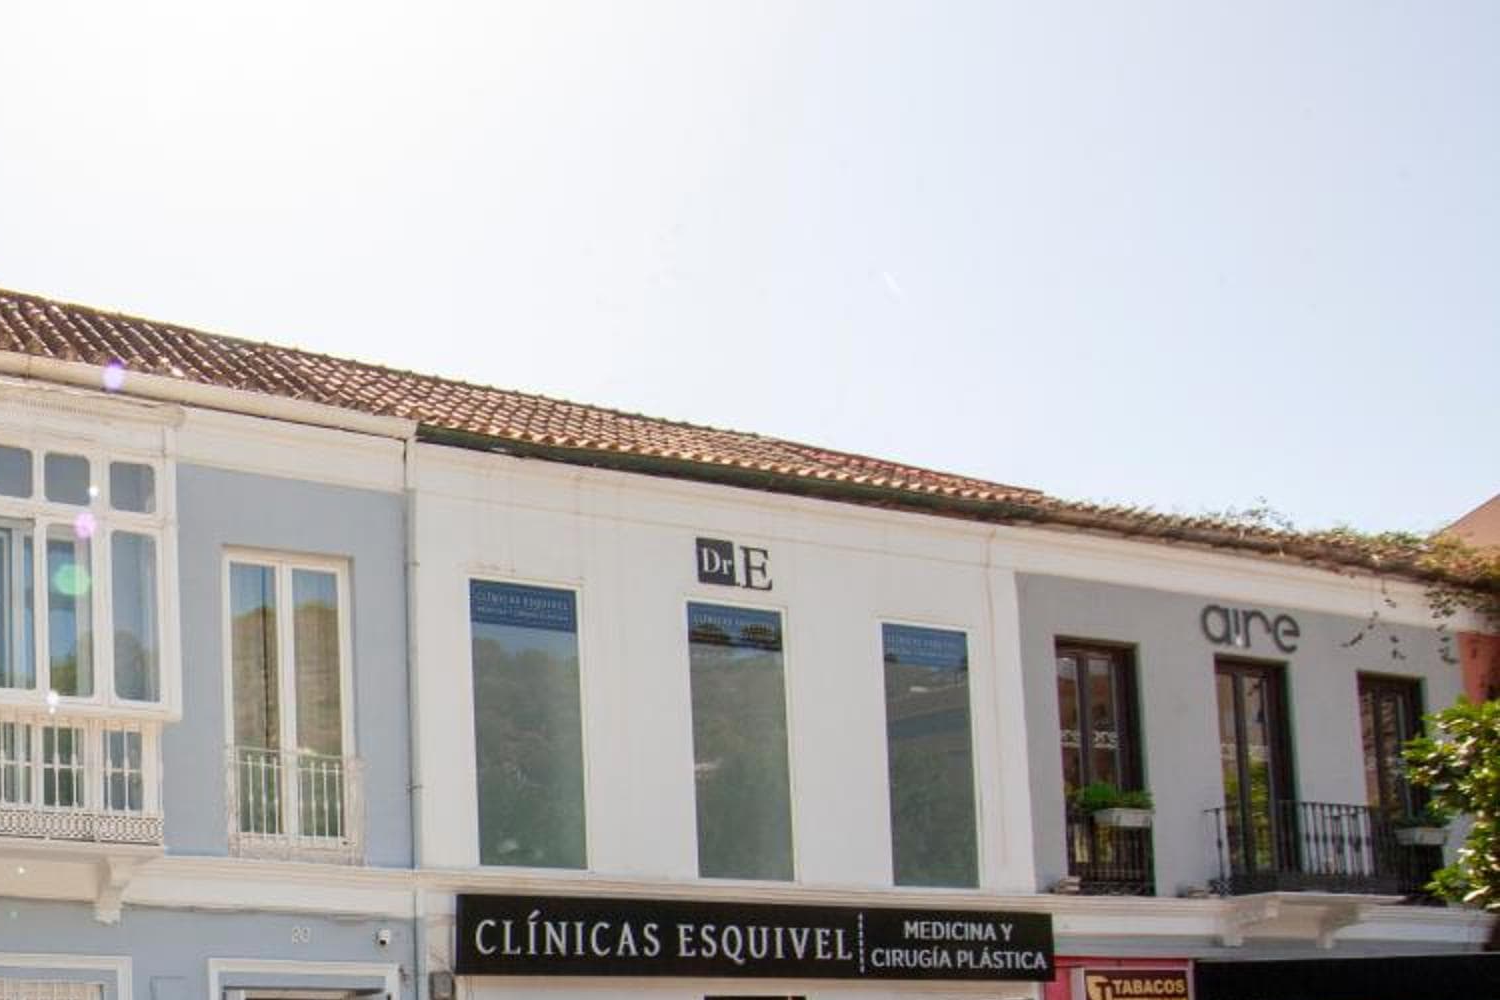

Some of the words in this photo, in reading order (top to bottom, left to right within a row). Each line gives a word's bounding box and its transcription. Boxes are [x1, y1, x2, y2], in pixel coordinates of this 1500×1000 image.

[475, 909, 661, 958] CLÍNICAS
[676, 922, 853, 965] ESQUIVEL
[903, 920, 997, 941] MEDICINA
[1001, 923, 1013, 942] Y
[870, 946, 952, 969] CIRUGÍA
[956, 946, 1048, 970] PLÁSTICA
[1112, 978, 1186, 995] TABACOS
